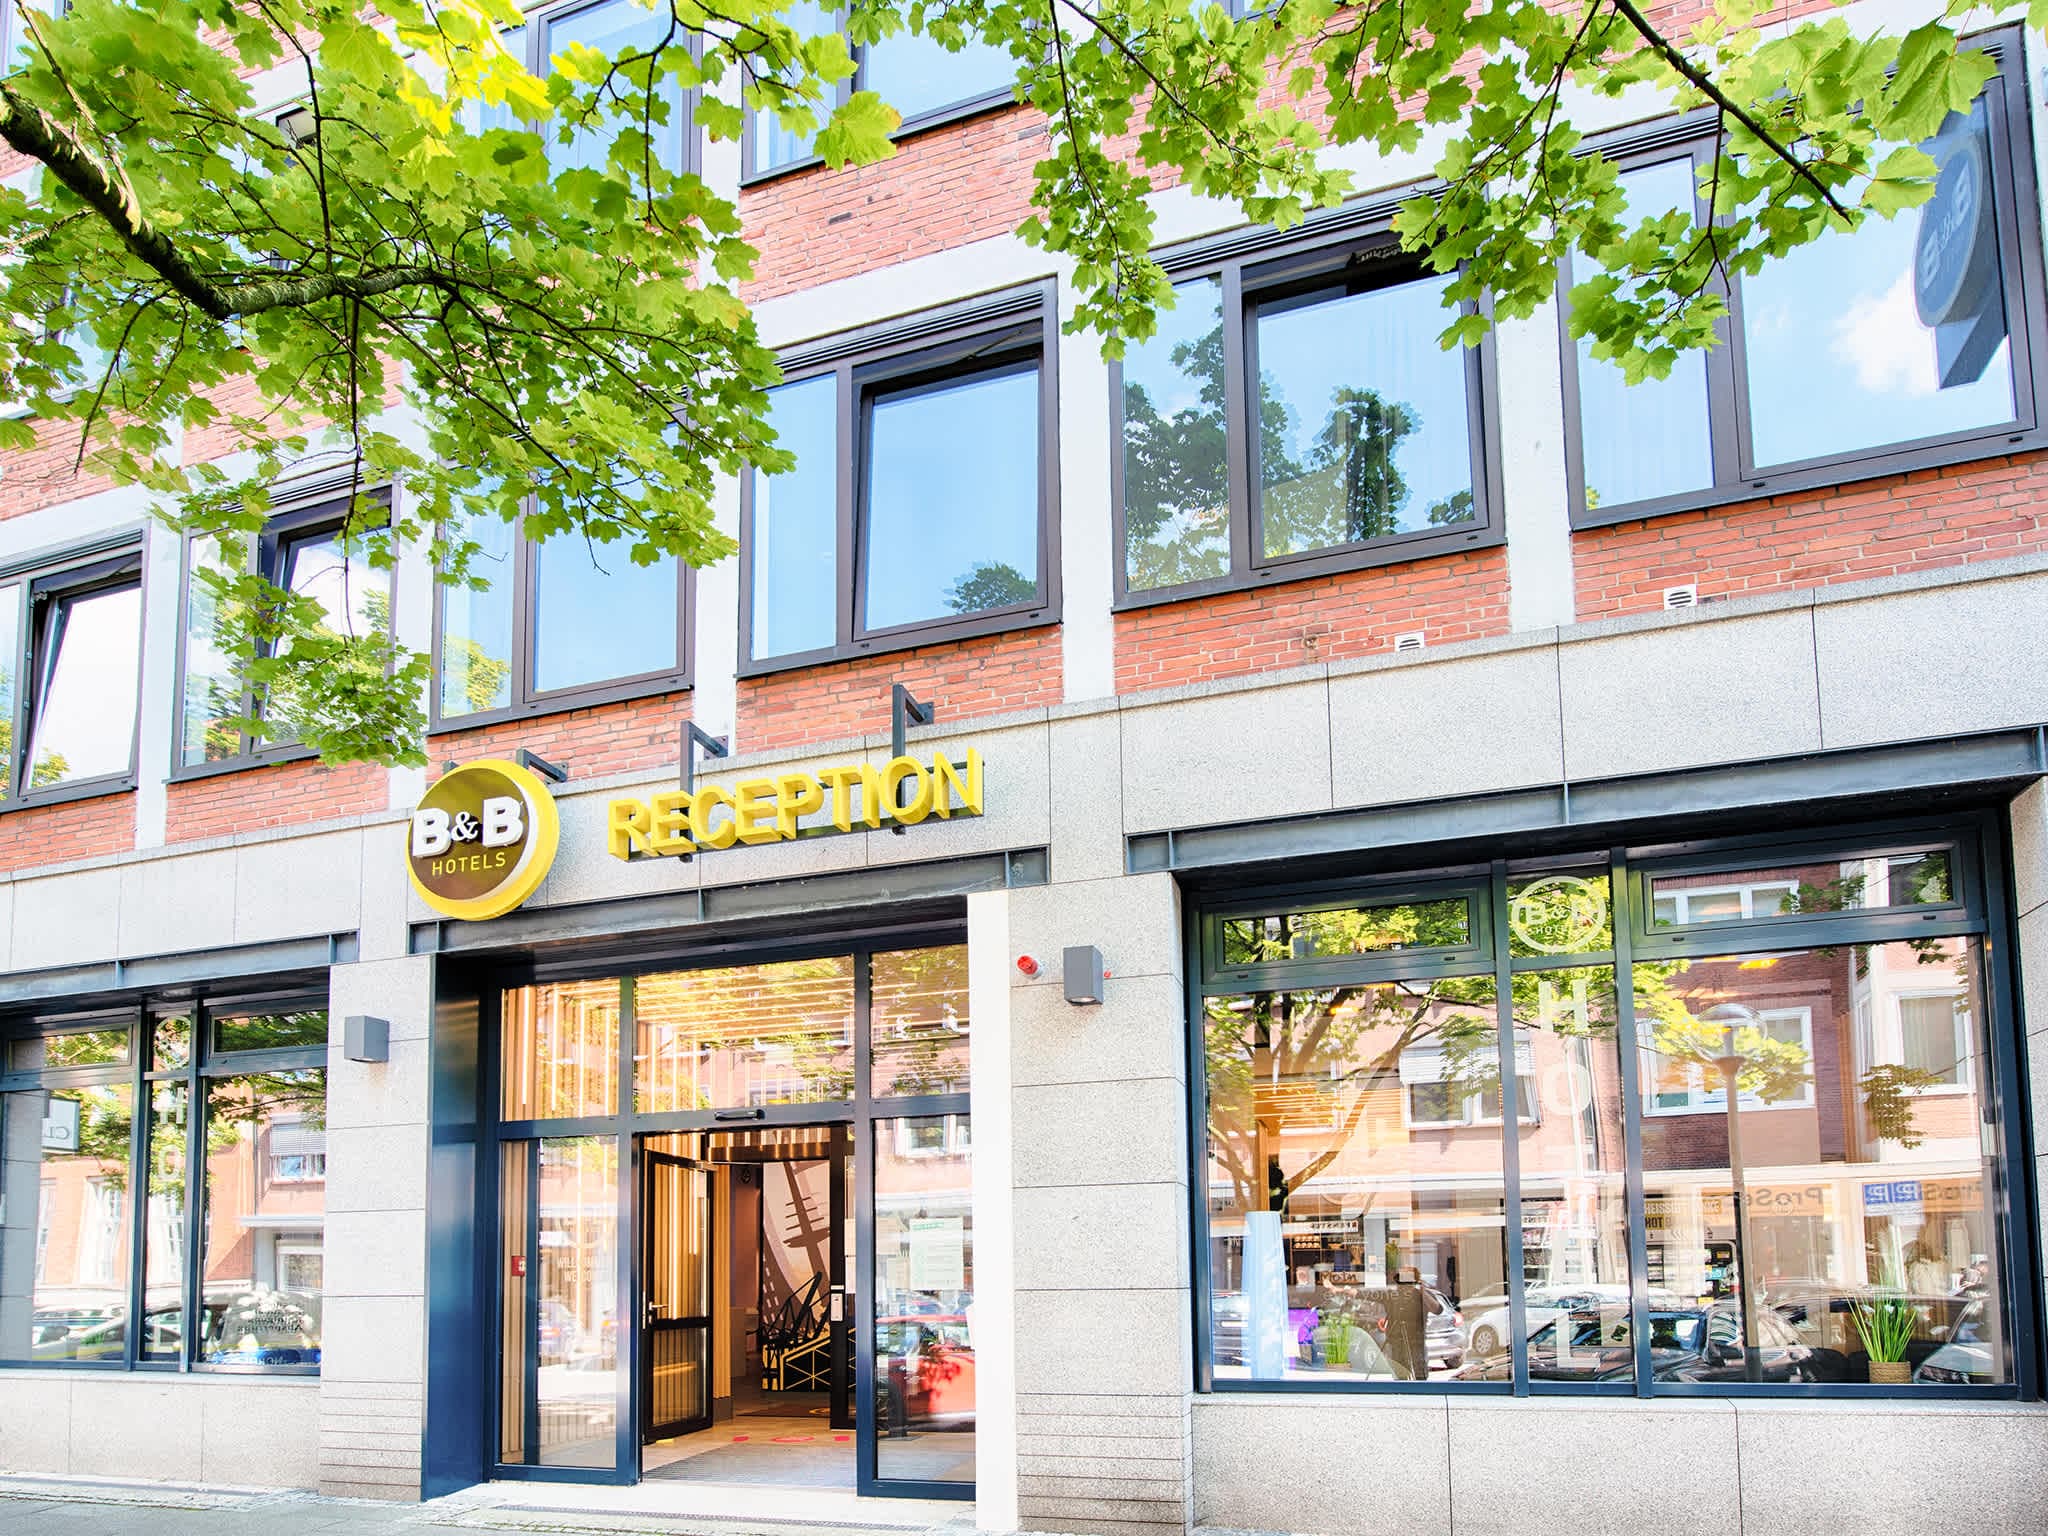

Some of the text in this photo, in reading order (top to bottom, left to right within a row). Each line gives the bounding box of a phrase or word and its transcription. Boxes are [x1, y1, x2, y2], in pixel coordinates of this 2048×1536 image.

[412, 796, 524, 859] B&B
[608, 747, 984, 860] RECEPTION
[431, 852, 506, 877] HOTELS
